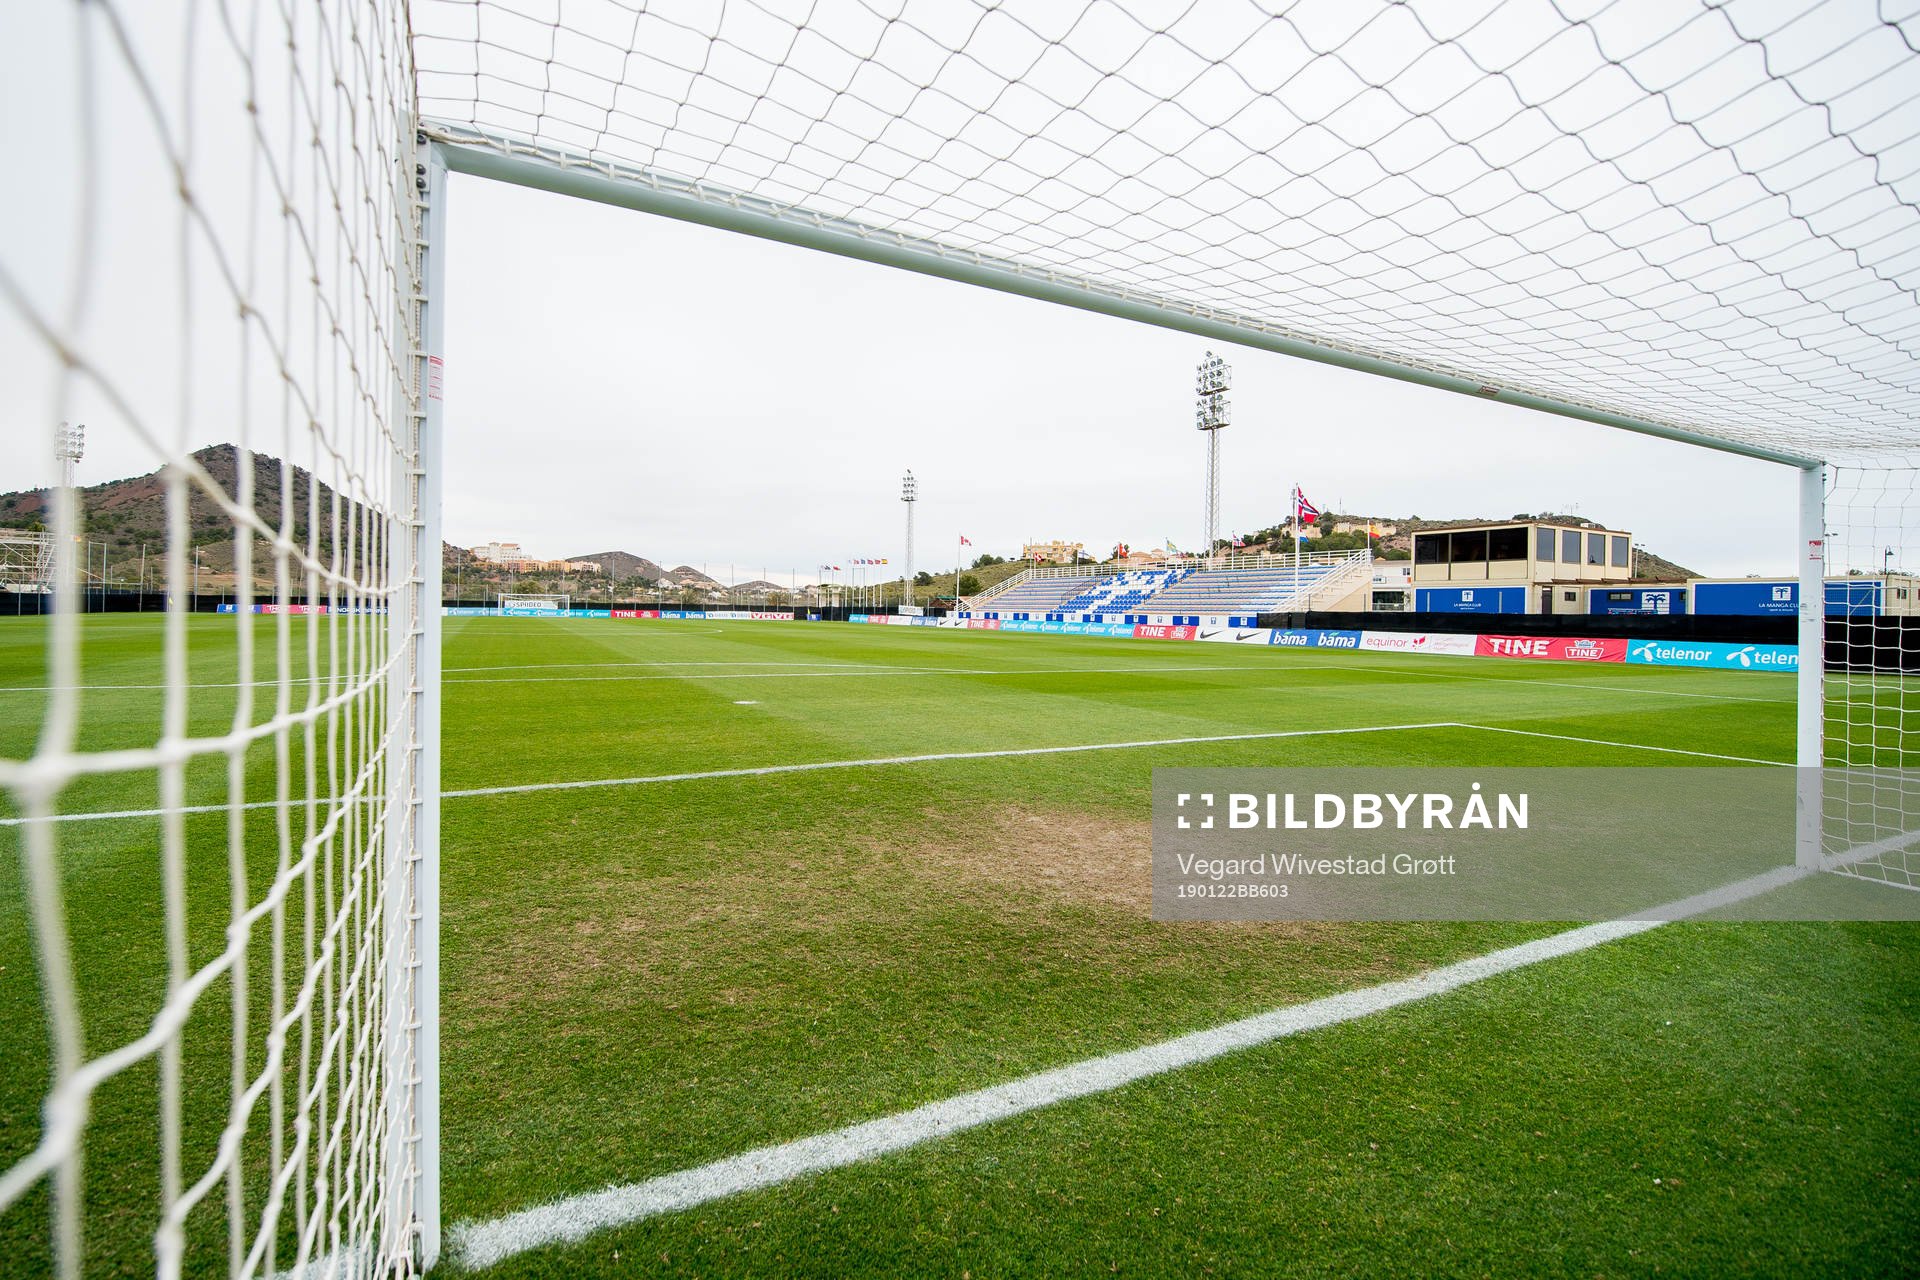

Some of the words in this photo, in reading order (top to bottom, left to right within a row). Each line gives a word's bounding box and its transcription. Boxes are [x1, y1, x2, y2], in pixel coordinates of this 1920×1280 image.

[1140, 626, 1165, 637] TINE
[1366, 635, 1409, 648] equinor
[1489, 638, 1550, 656] TINE
[1569, 648, 1598, 657] TINE
[1656, 646, 1712, 661] telenor
